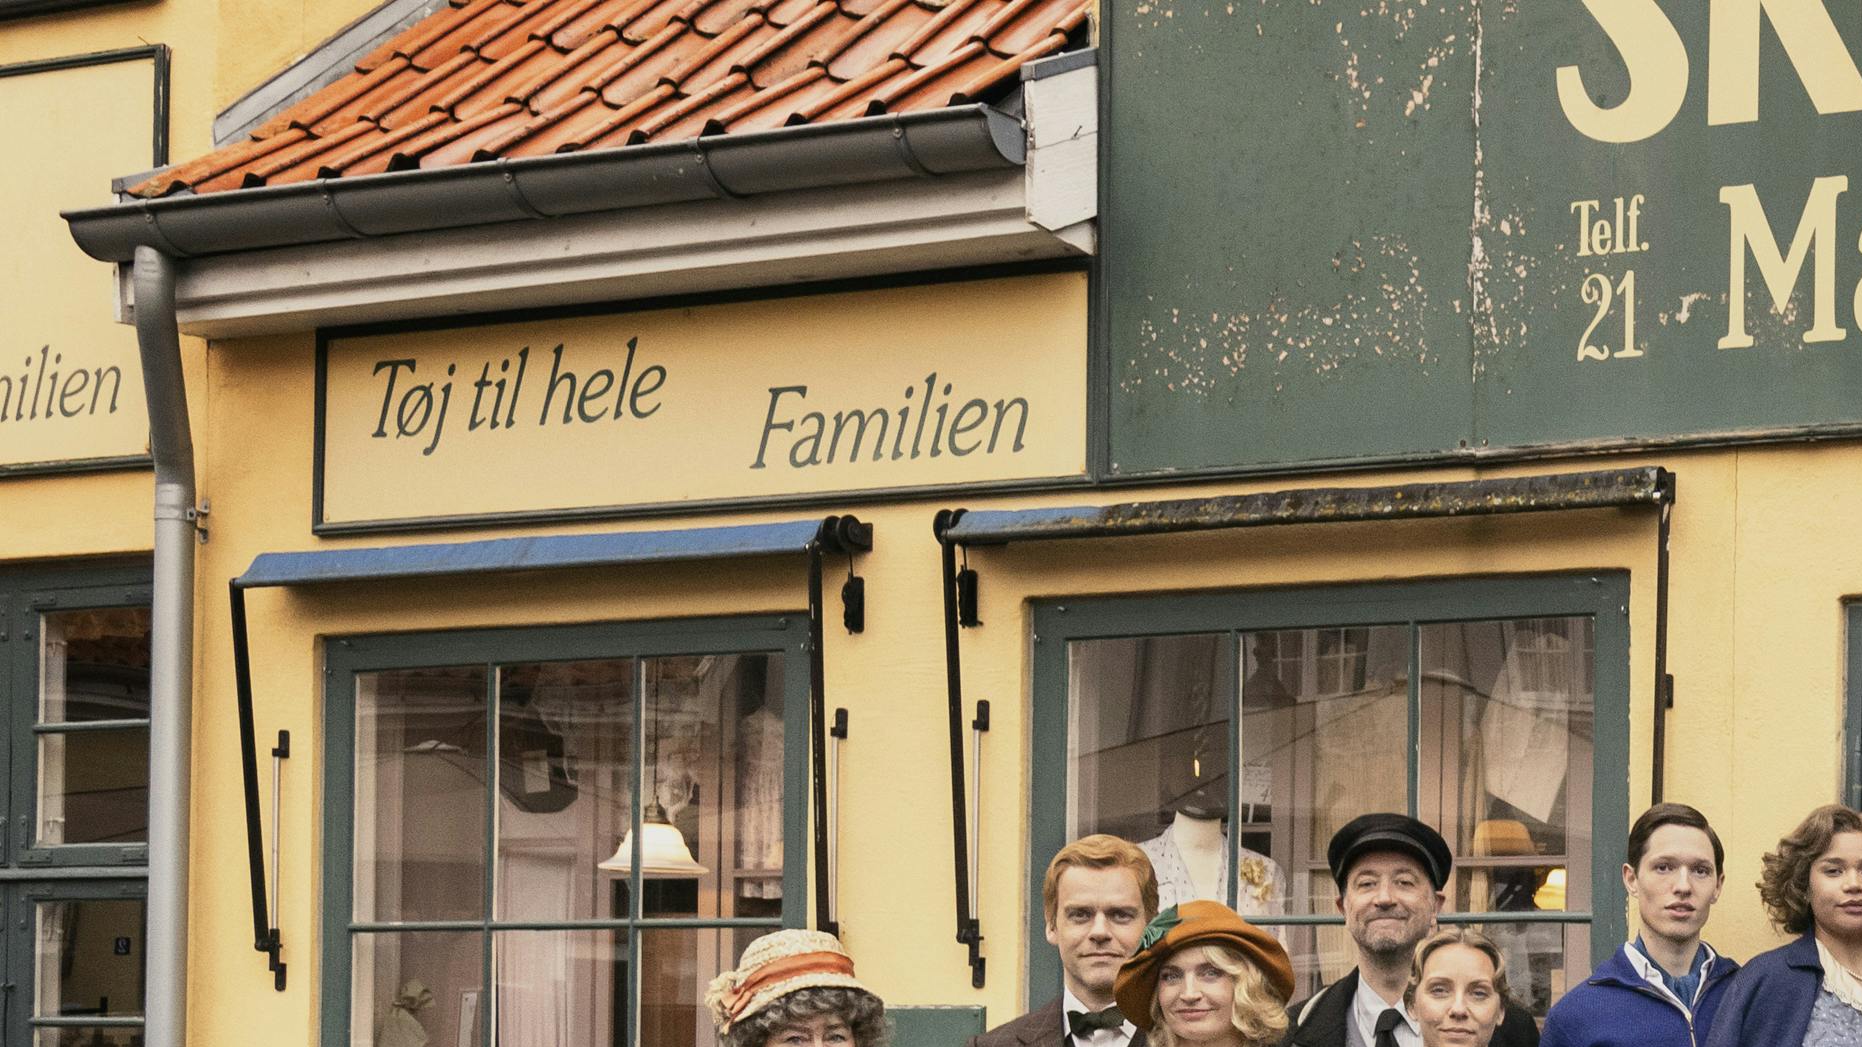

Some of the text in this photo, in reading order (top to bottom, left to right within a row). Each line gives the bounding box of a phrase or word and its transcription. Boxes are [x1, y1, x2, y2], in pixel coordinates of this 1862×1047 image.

[1570, 194, 1649, 257] Telf.
[1576, 269, 1644, 362] 21
[0, 344, 121, 423] ilien
[371, 336, 667, 456] Tøj til hele
[749, 372, 1029, 469] Familien
